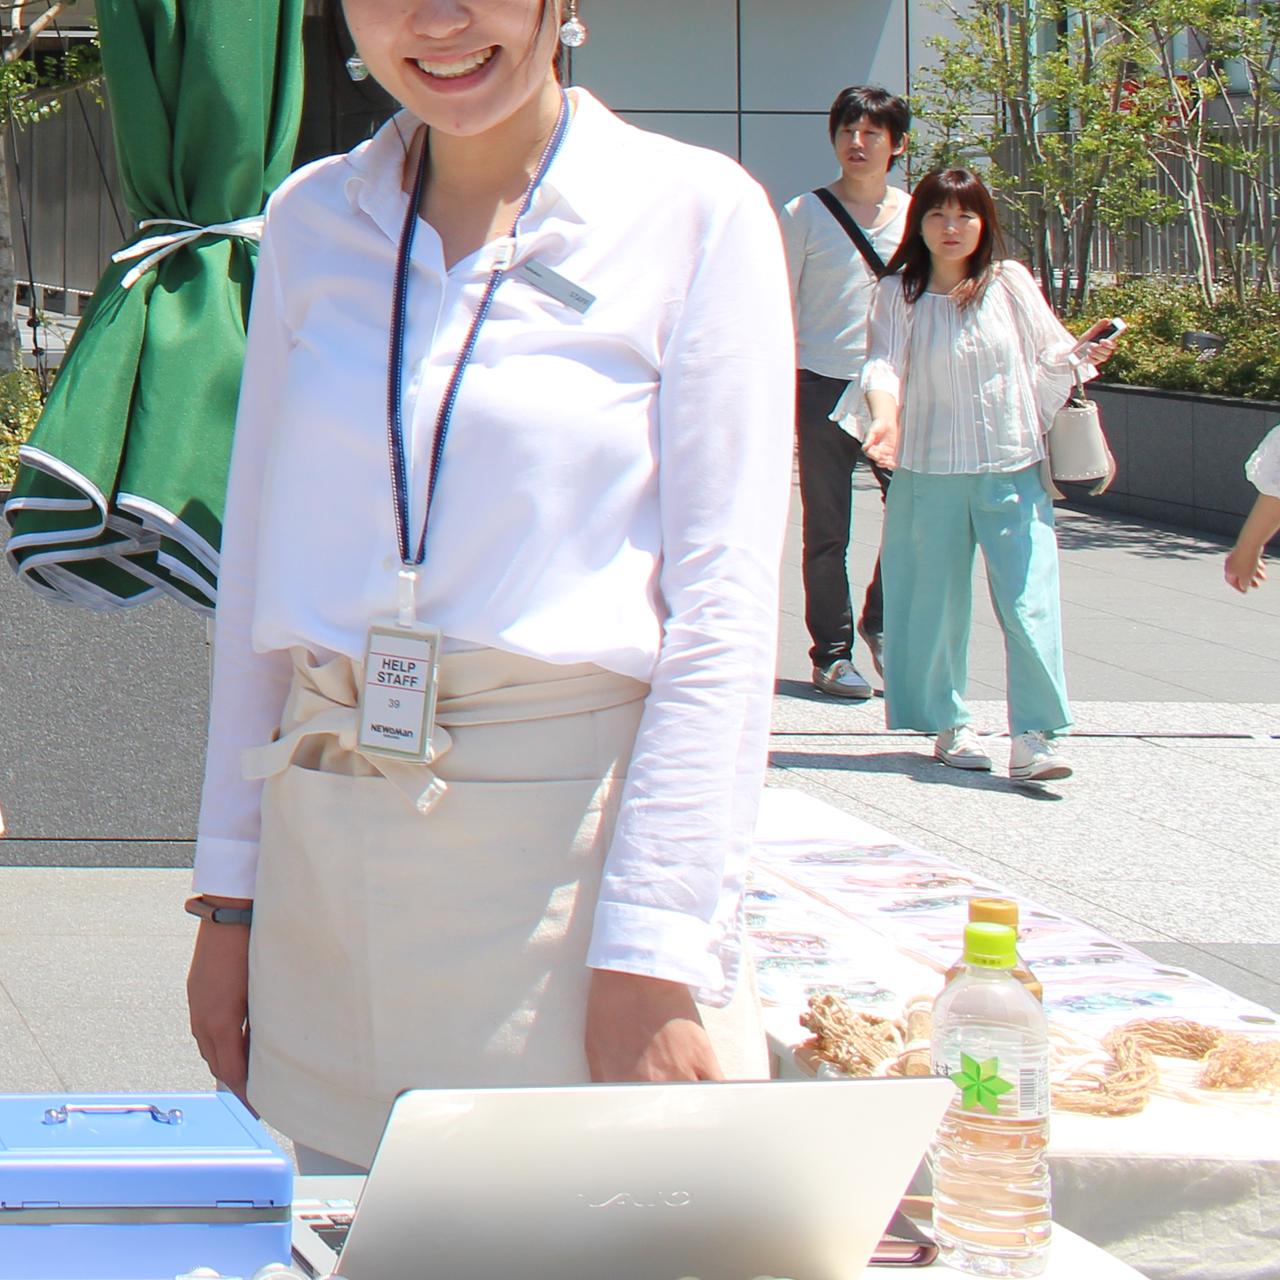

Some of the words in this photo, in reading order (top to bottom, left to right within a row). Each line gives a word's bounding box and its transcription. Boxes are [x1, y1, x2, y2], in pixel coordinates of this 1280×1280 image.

[382, 658, 416, 673] HELP
[377, 671, 418, 688] STAFF
[388, 698, 400, 709] 39
